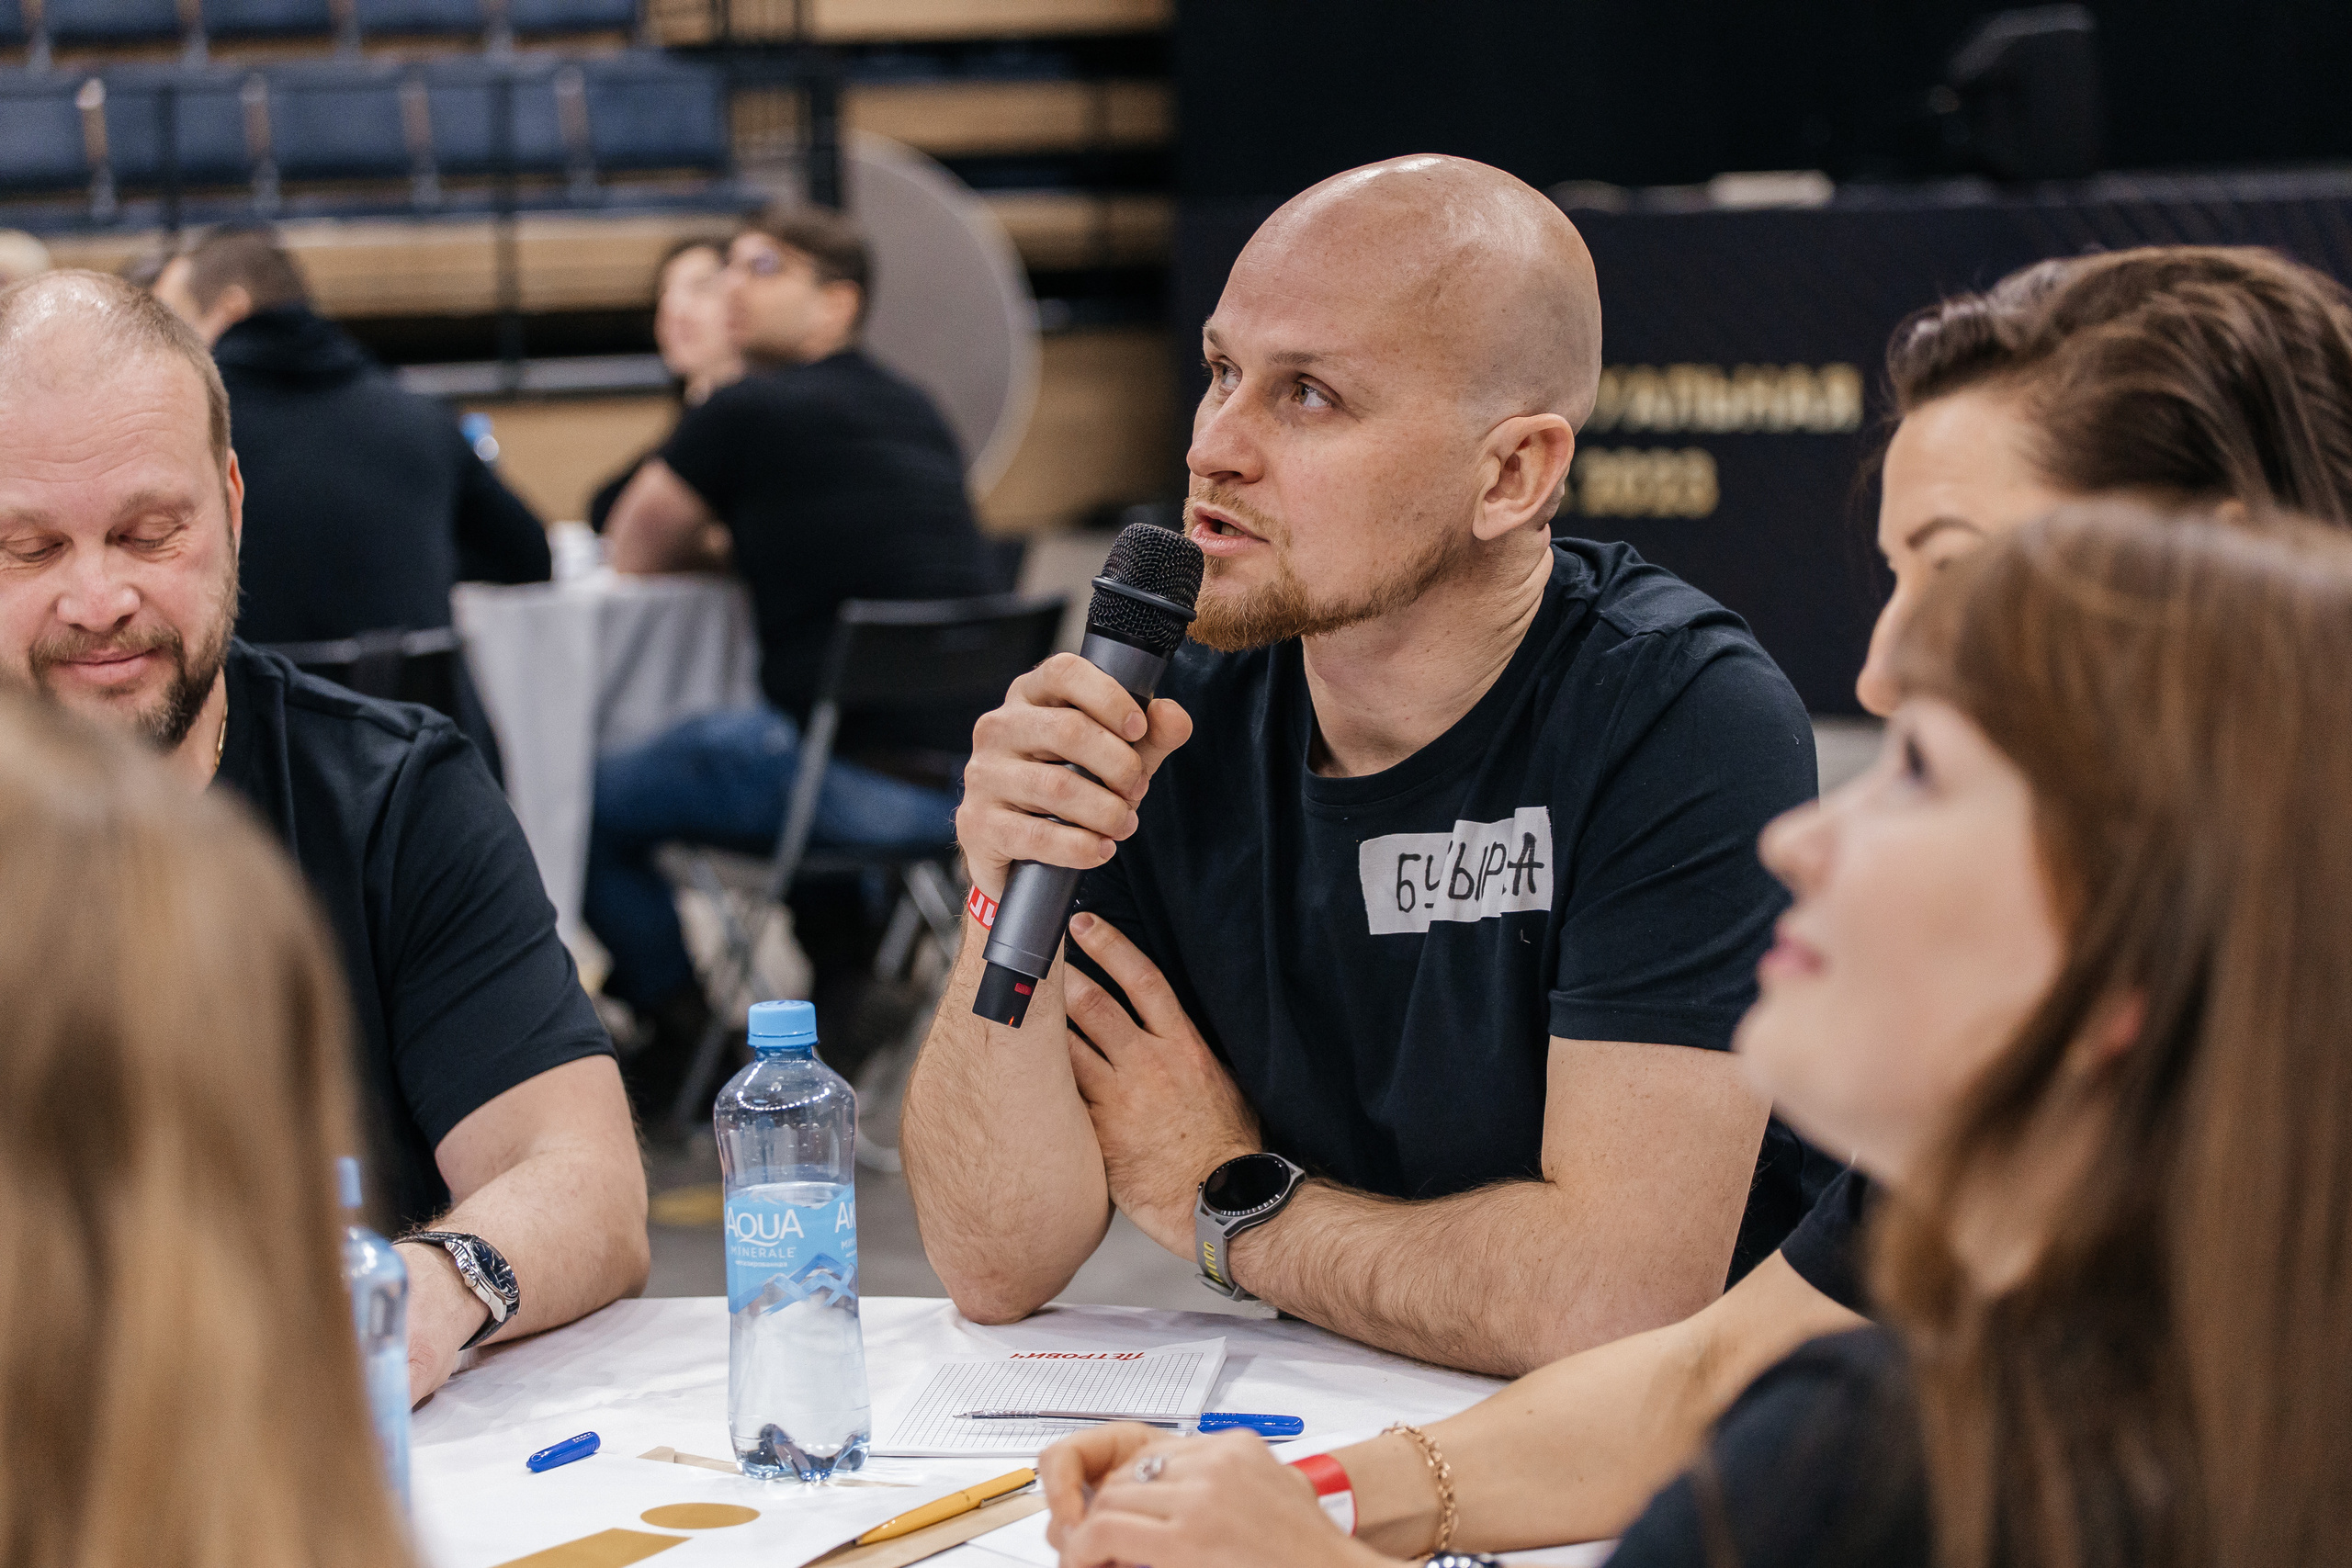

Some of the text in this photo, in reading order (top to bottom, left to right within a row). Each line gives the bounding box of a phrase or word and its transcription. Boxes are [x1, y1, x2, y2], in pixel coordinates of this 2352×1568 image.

[726, 1206, 805, 1247] AQUA
[730, 1246, 797, 1258] MINERALE
[1010, 1351, 1145, 1361] ПЕТРОВИЧ
